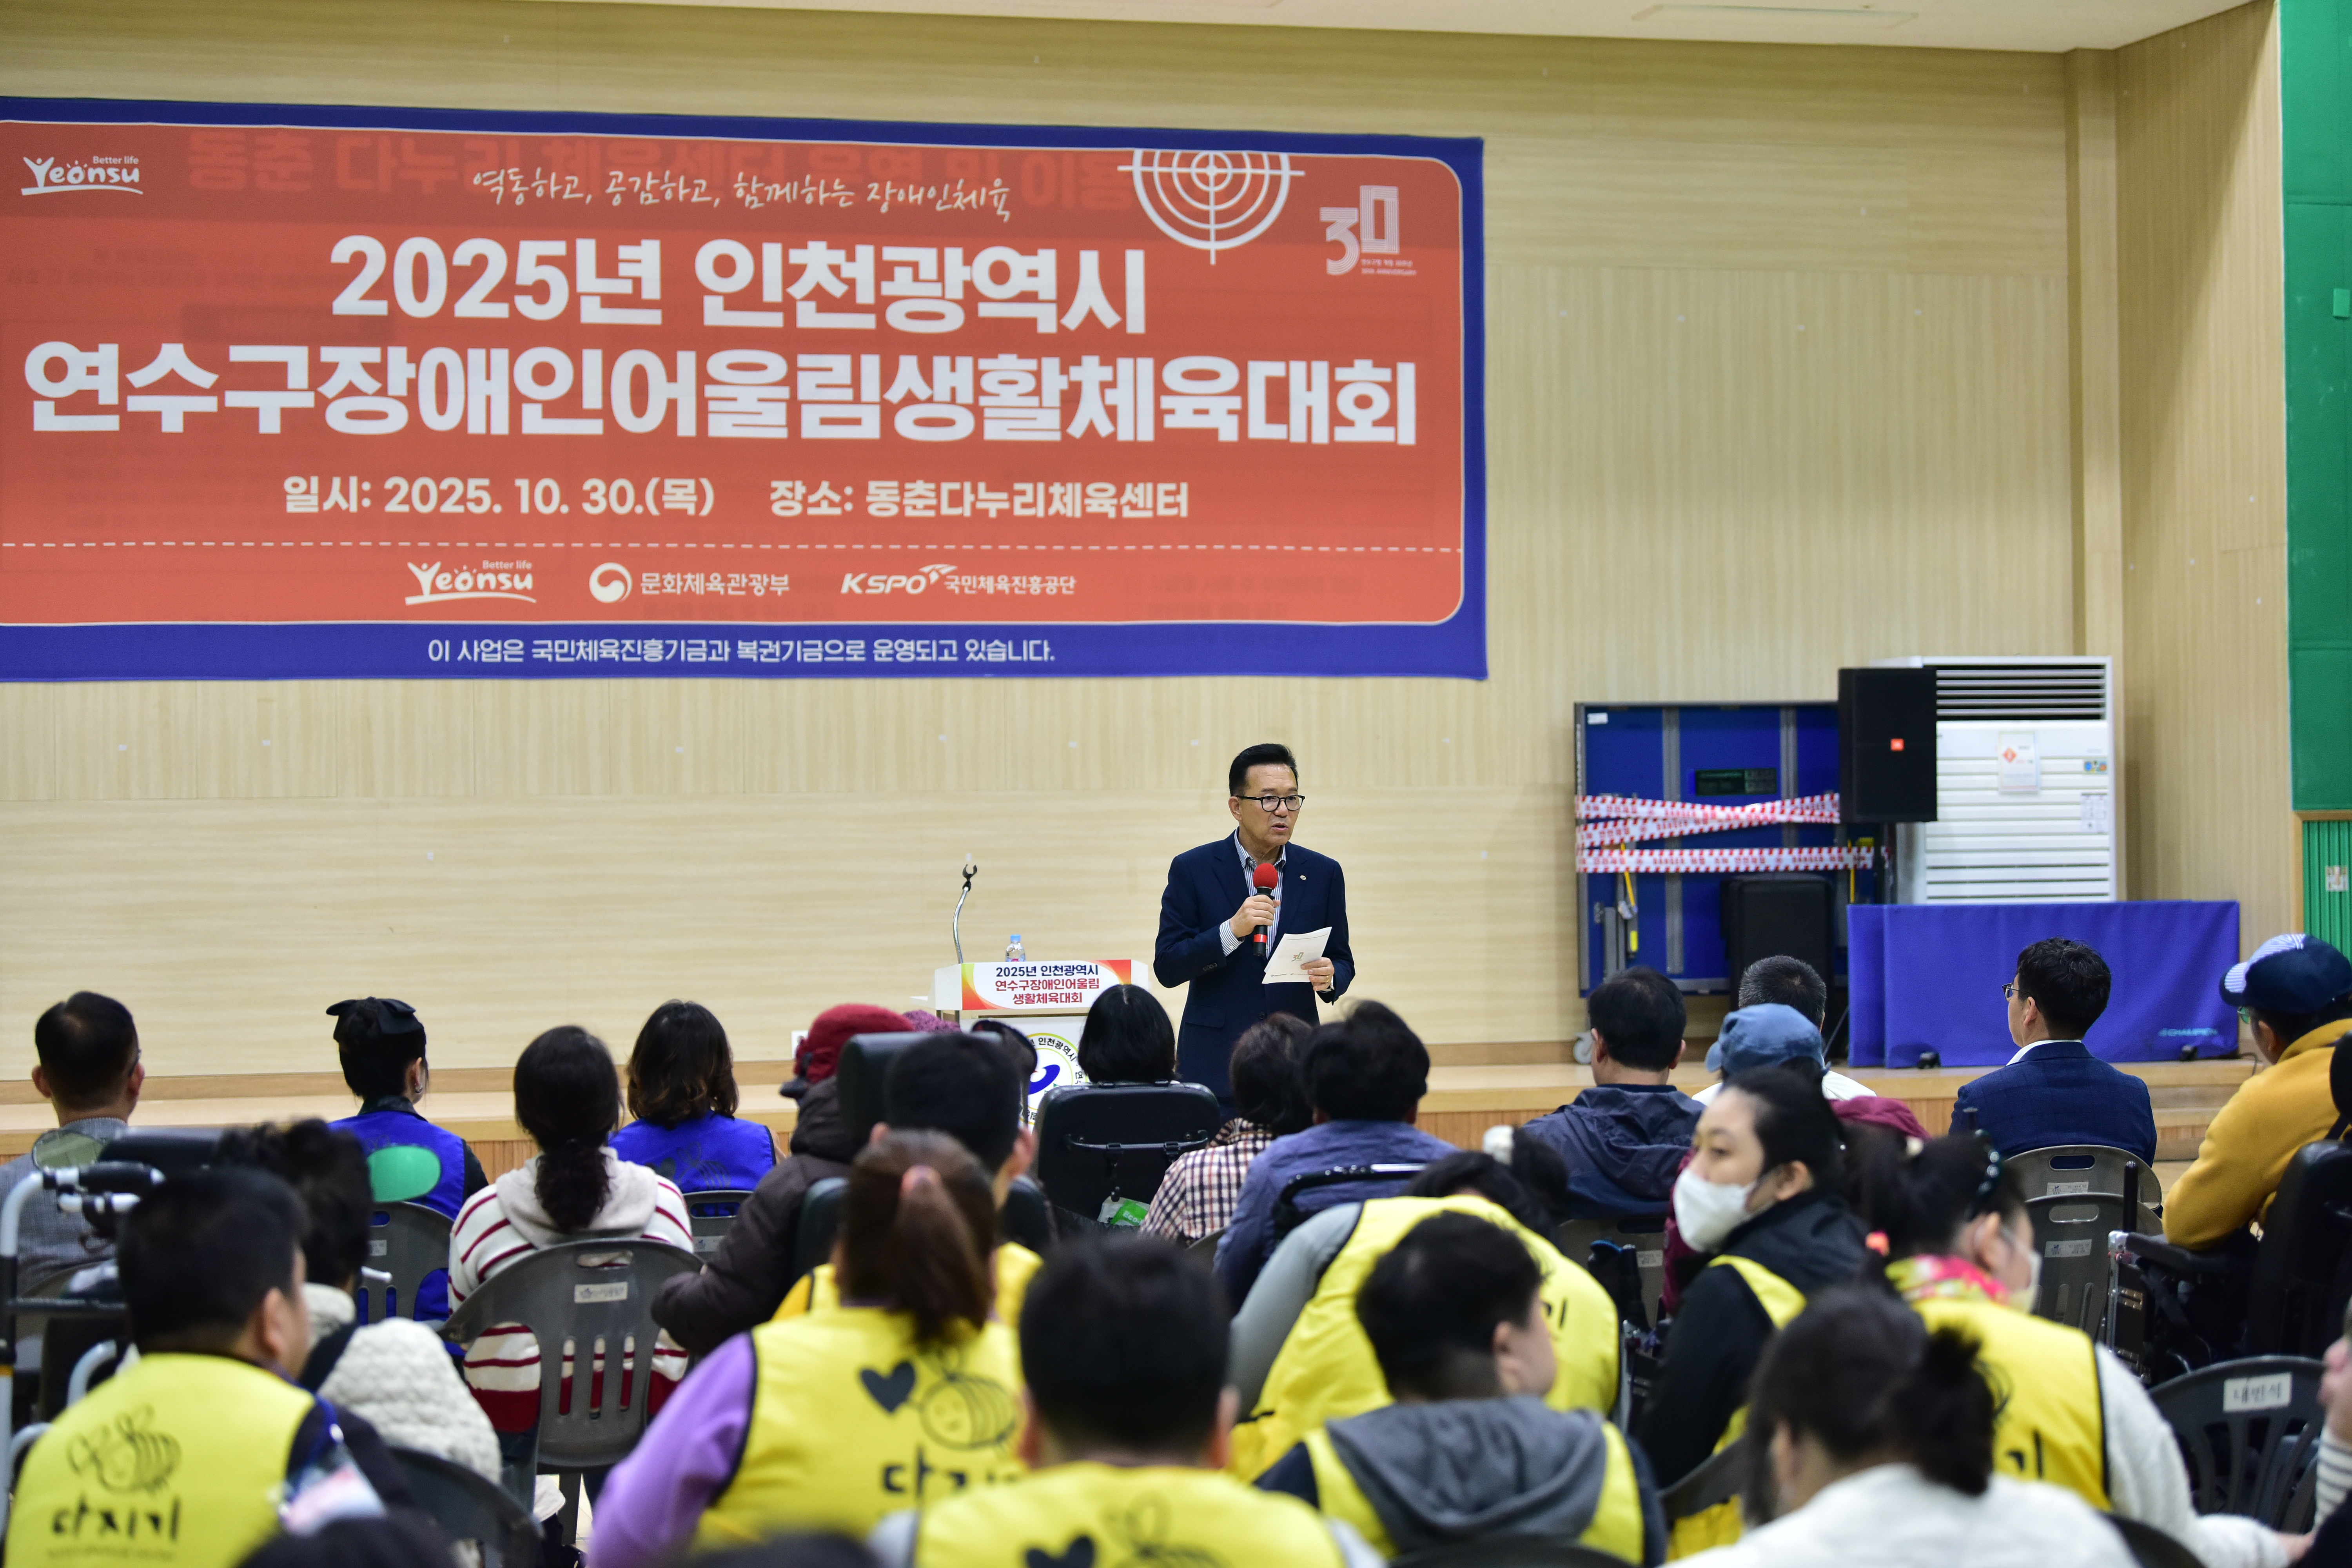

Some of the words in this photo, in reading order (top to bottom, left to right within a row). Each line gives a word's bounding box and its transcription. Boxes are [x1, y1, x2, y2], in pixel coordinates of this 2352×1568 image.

[23, 156, 140, 188] Yeonsu
[93, 156, 122, 164] Better
[124, 156, 139, 165] life
[473, 167, 592, 206] 역동하고,
[605, 170, 720, 207] 공감하고,
[733, 171, 855, 209] 함께하는
[867, 178, 1010, 222] 장애인체육
[1319, 185, 1399, 276] 30
[330, 234, 662, 326] 2025년
[694, 238, 1146, 334] 인천광역시
[24, 341, 1417, 446] 연수구장애인어울림생활체육대회
[283, 475, 372, 514] 일시:
[383, 475, 503, 515] 2025.
[514, 477, 570, 516] 10.
[581, 476, 715, 517] 30.(목)
[769, 479, 854, 518] 장소:
[865, 479, 1189, 520] 동춘다누리체육센터
[482, 559, 514, 570] Better
[516, 559, 533, 570] life
[407, 561, 533, 597] Yeonsu
[640, 572, 790, 597] 문화체육관광부
[840, 572, 927, 595] KSPO
[944, 574, 1076, 595] 국민체육진흥공단
[428, 639, 450, 662] 이
[457, 639, 525, 663] 사업은
[531, 638, 731, 662] 국민체육진흥기금과
[736, 639, 866, 663] 복권기금으로
[872, 638, 959, 663] 운영되고
[964, 638, 1055, 662] 있습니다.
[996, 966, 1037, 977] 2025년
[1040, 965, 1098, 976] 인천광역시
[995, 978, 1100, 991] 연수구장애인어울림
[1013, 992, 1082, 1005] 생활체육대회
[1038, 1037, 1077, 1062] 인천광역시
